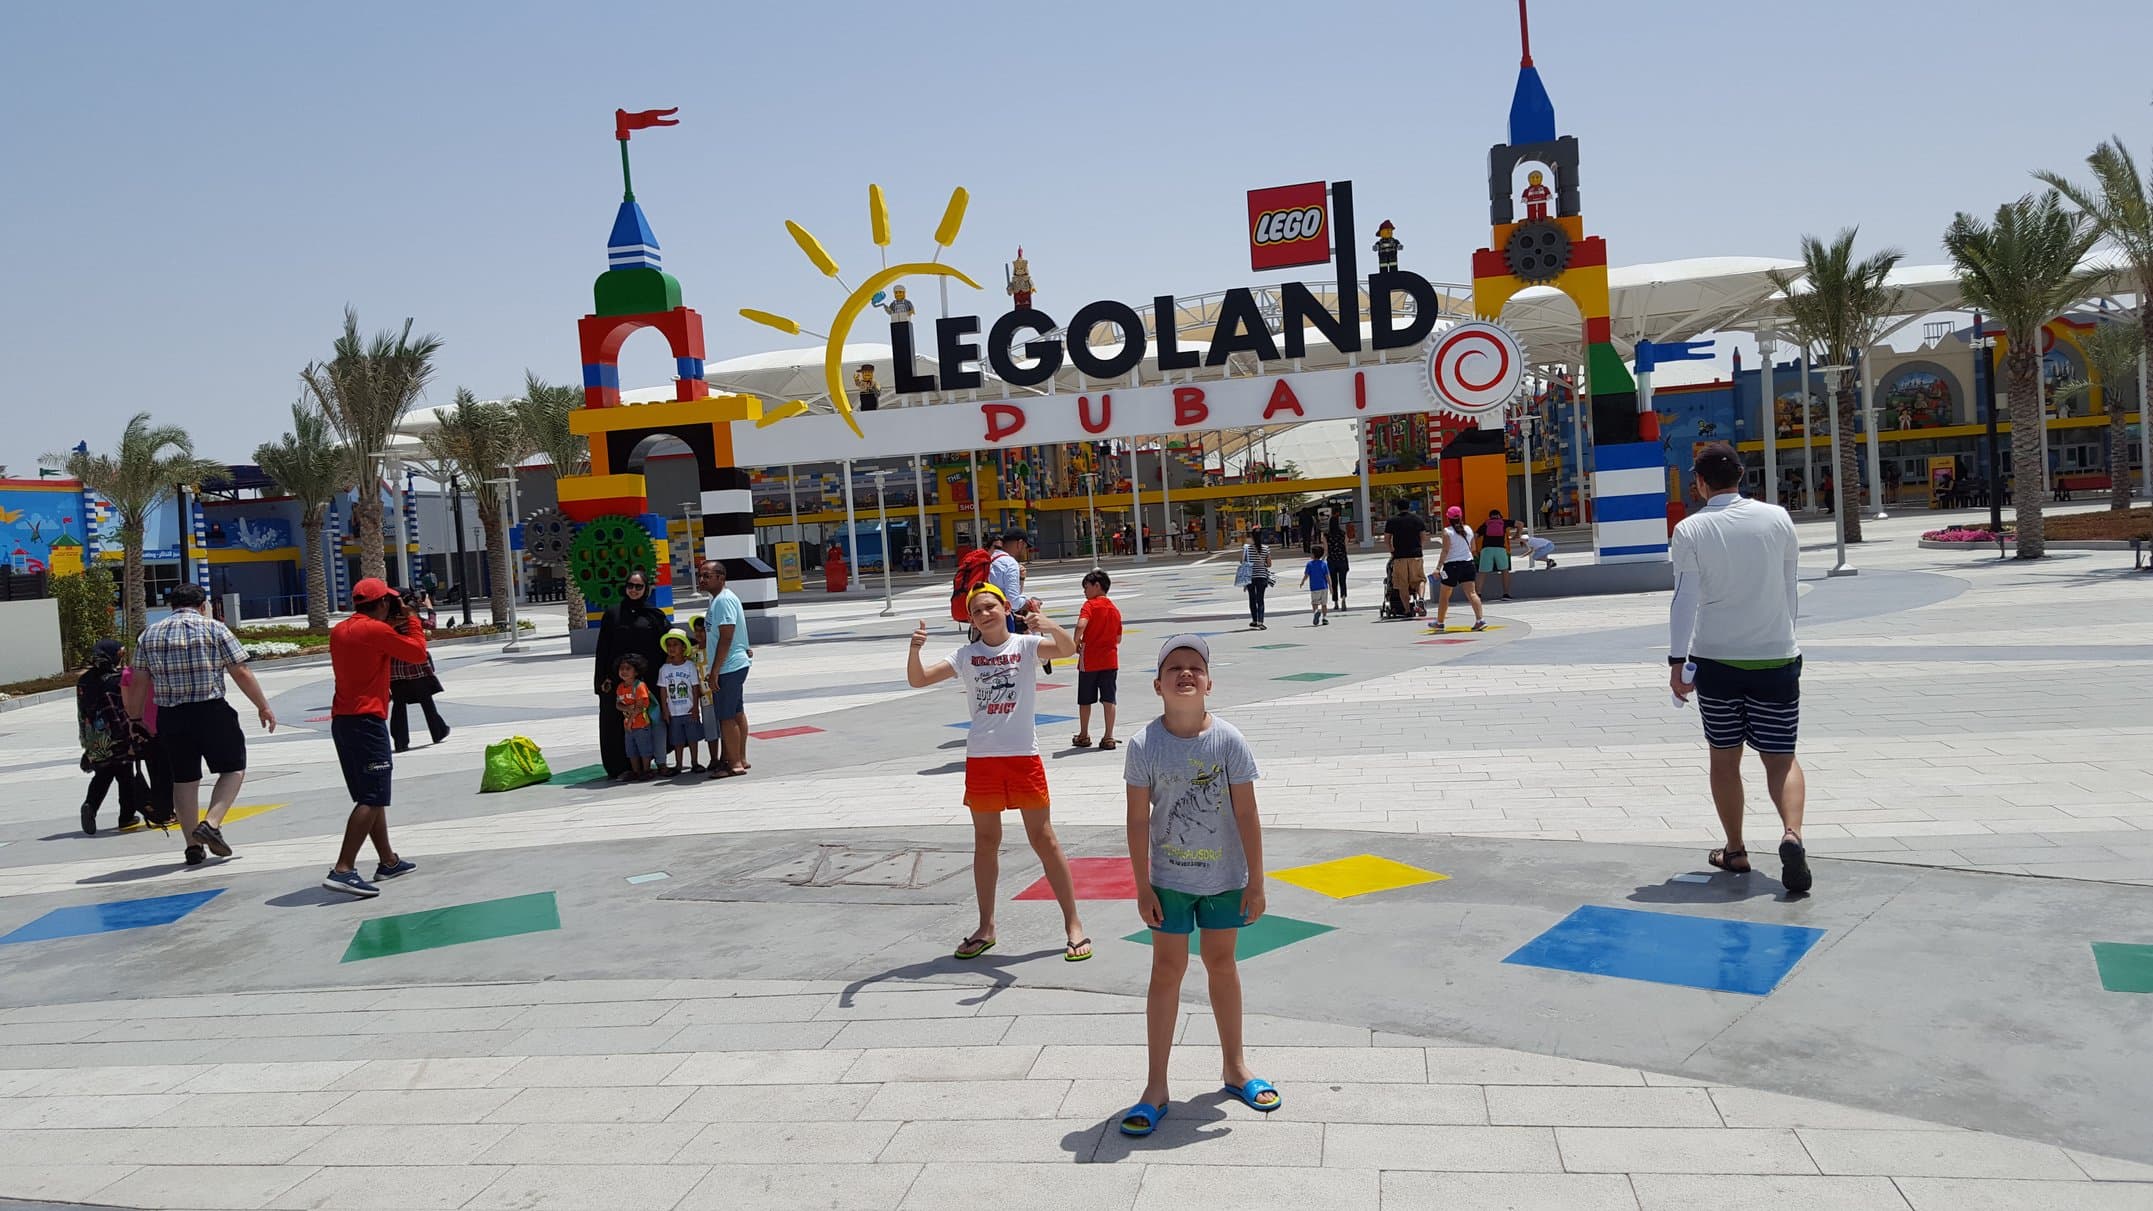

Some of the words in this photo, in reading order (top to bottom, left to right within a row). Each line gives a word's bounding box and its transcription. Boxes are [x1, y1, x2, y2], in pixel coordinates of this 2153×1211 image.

[1254, 206, 1322, 245] LEGO
[890, 180, 1439, 394] LEGOLAND
[980, 371, 1366, 442] DUBAI
[947, 473, 961, 483] THE
[959, 503, 977, 511] SHO
